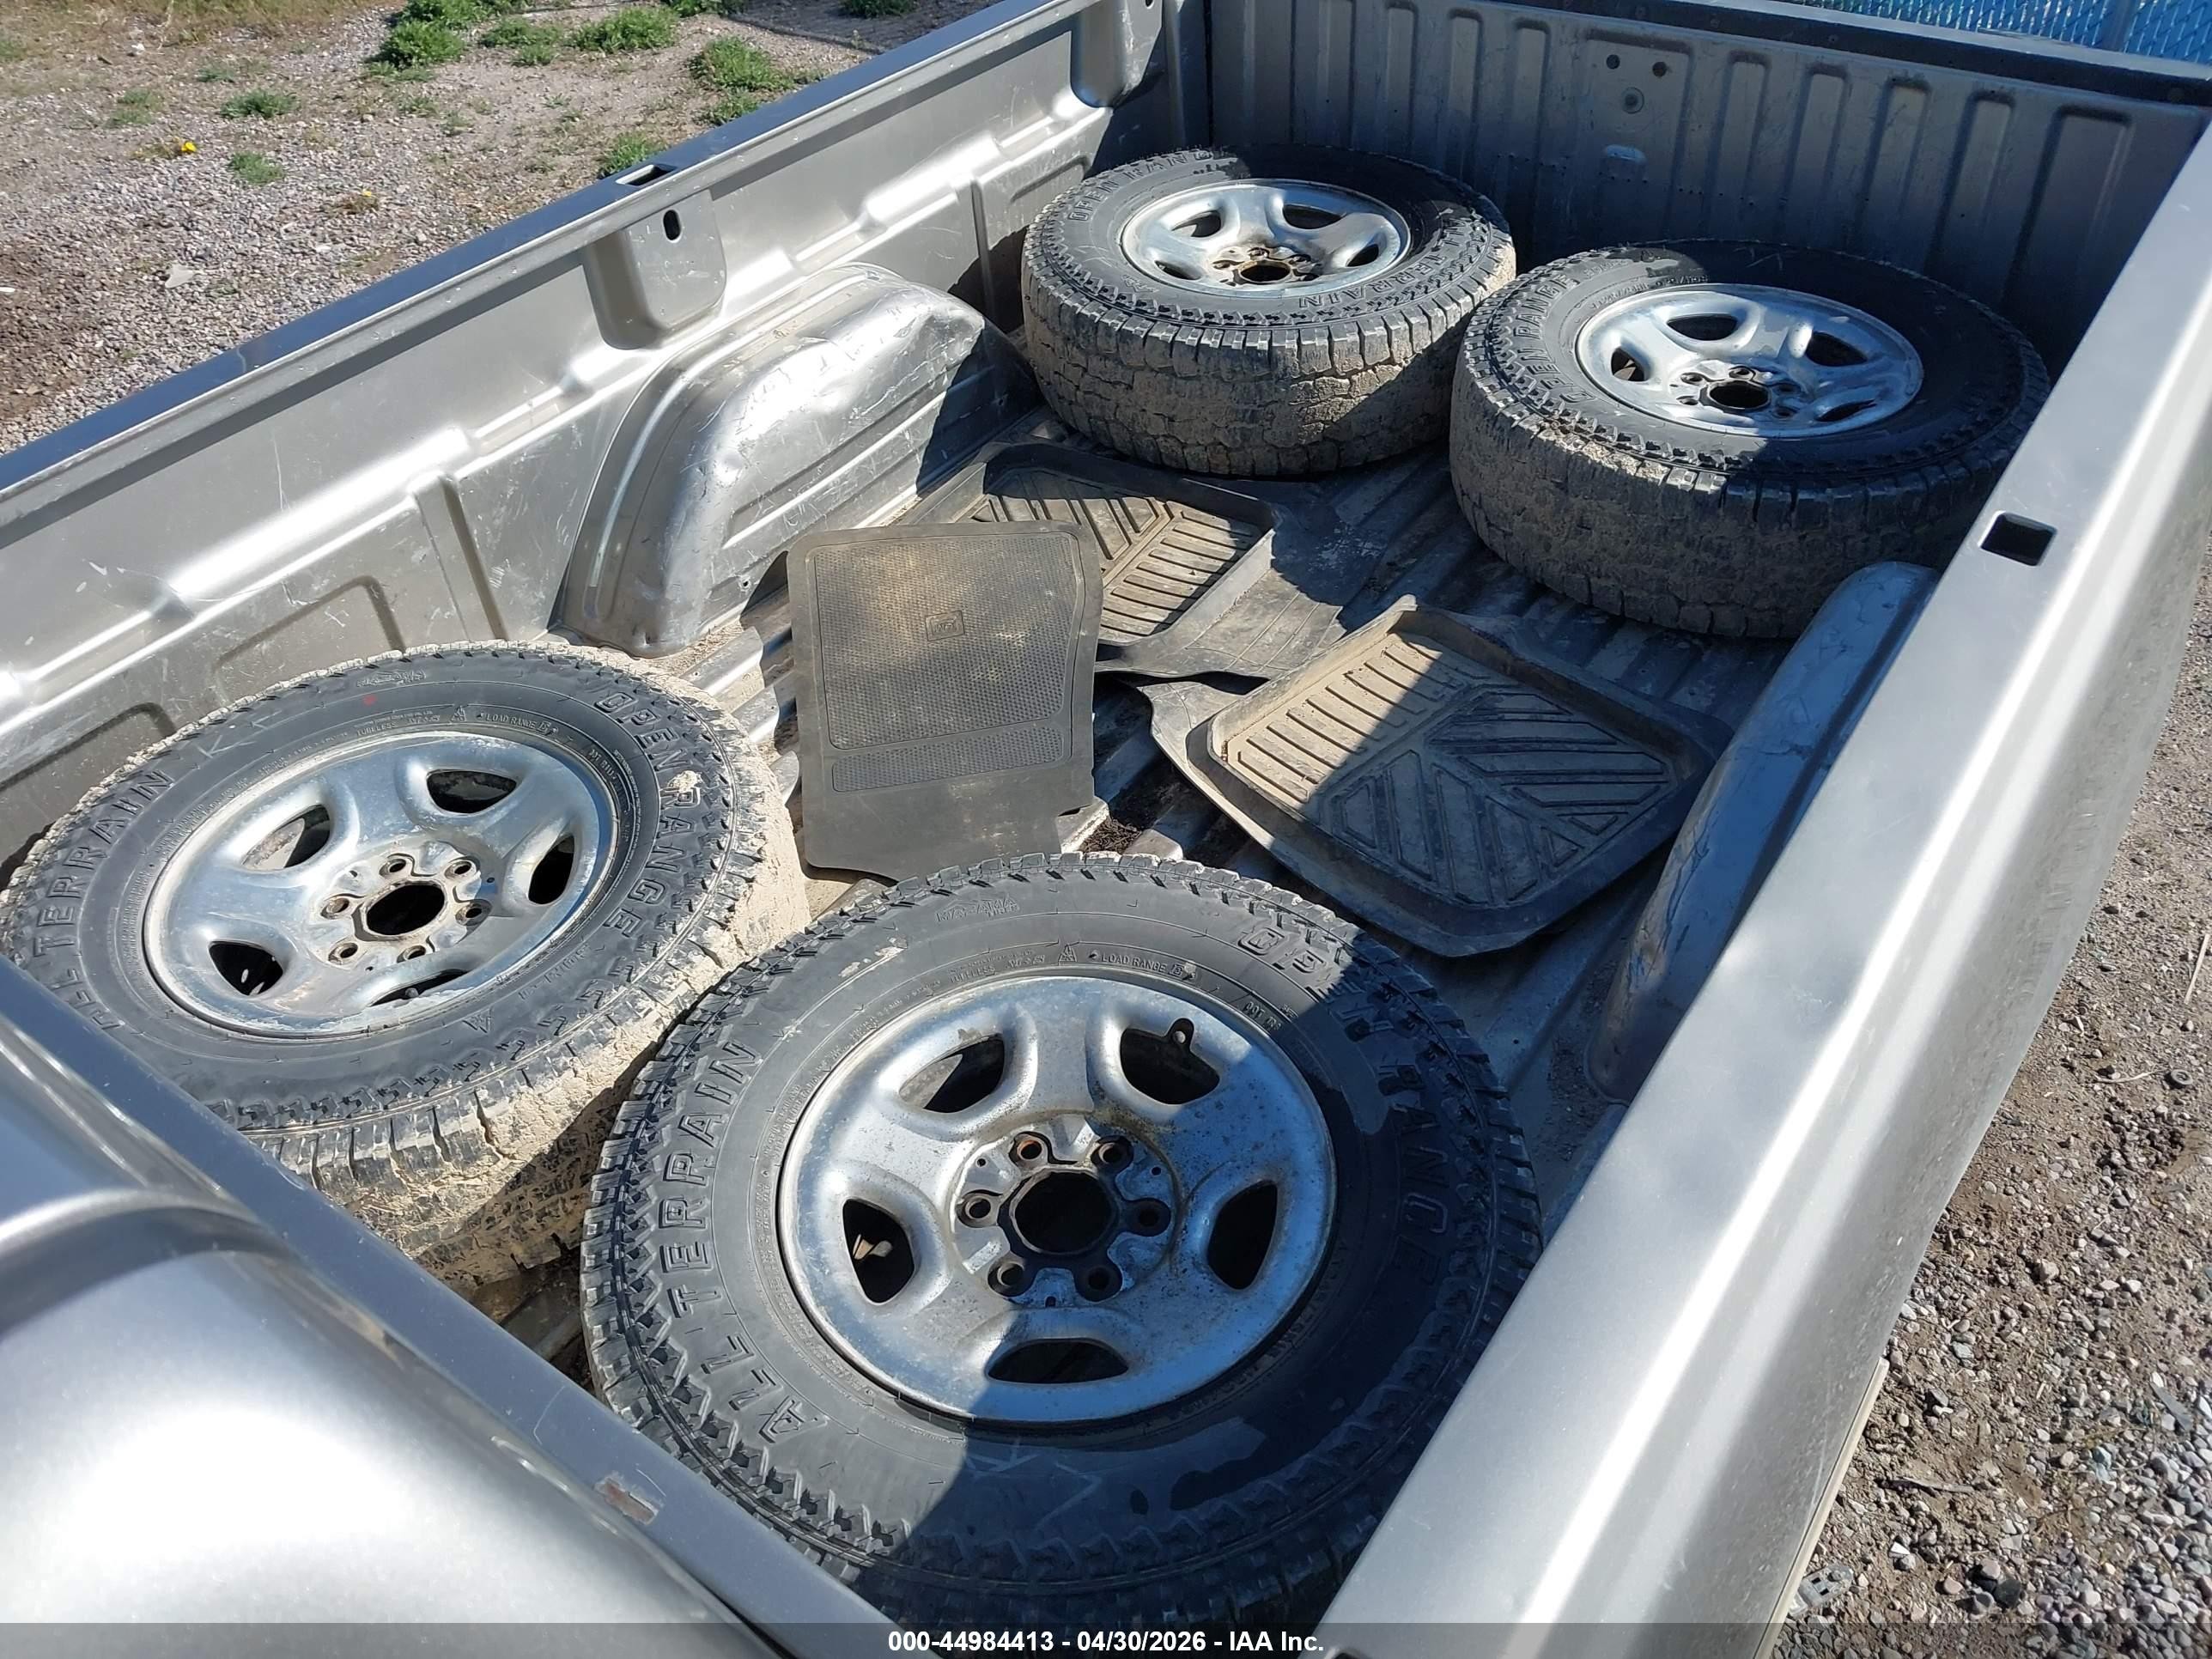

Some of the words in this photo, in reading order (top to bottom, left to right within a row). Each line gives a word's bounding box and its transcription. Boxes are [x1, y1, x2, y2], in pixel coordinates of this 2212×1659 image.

[1067, 179, 1119, 222] OPEN
[1298, 252, 1448, 308] TERRAIN
[1514, 272, 1581, 339] RANGE
[1518, 345, 1598, 404] OPEN
[485, 713, 509, 724] LOAD
[594, 691, 685, 773] OPEN
[32, 770, 175, 957] TERRAIN
[604, 782, 702, 938] RANGE
[1101, 953, 1132, 968] LOAD
[1132, 957, 1168, 974] RANGE
[659, 1036, 763, 1318] TERRAIN
[1377, 1063, 1449, 1285] RANGE
[701, 1333, 823, 1443] ALL
